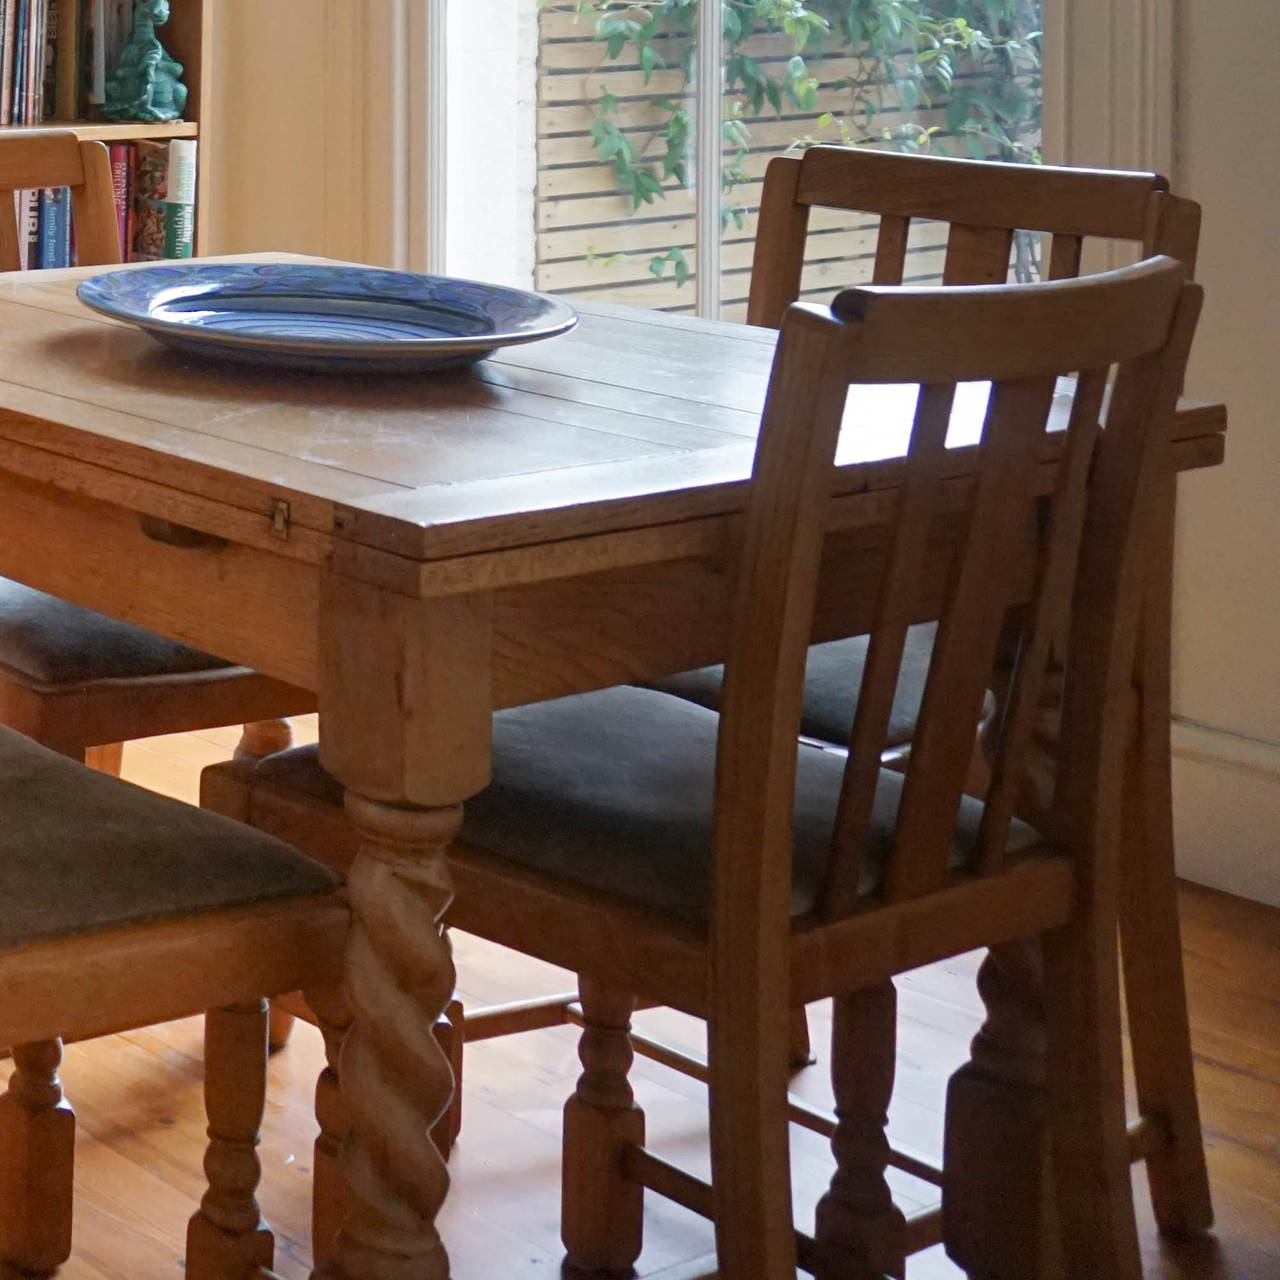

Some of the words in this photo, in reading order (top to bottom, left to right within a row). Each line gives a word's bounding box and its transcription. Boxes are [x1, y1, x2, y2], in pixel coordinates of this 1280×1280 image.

[112, 161, 122, 206] GRILLING
[46, 206, 57, 236] family
[174, 208, 185, 258] Appetite
[48, 239, 57, 262] food
